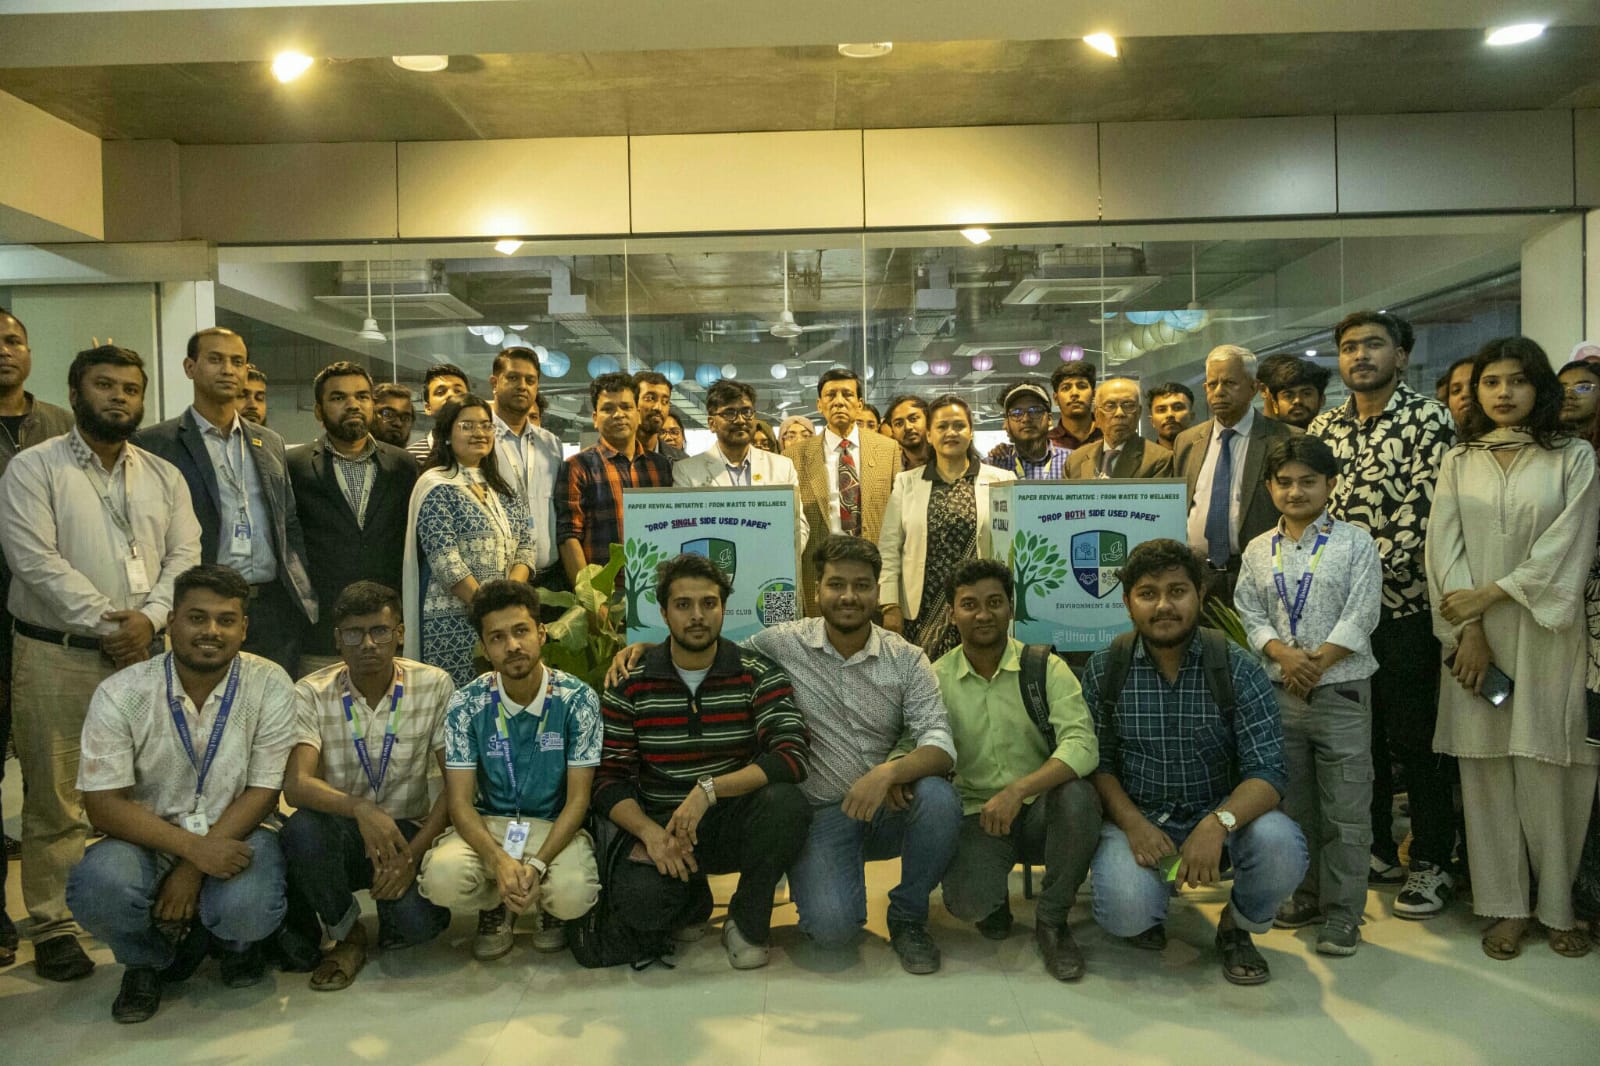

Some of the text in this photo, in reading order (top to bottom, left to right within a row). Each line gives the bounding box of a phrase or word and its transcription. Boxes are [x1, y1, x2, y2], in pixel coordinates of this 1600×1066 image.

[1038, 509, 1160, 523] "DROP BOTH SIDE USED PAPER"
[645, 517, 771, 532] "DROP SINGLE SIDE USED PAPER"
[736, 608, 752, 616] CLUB
[1065, 629, 1116, 643] Uttara Uni
